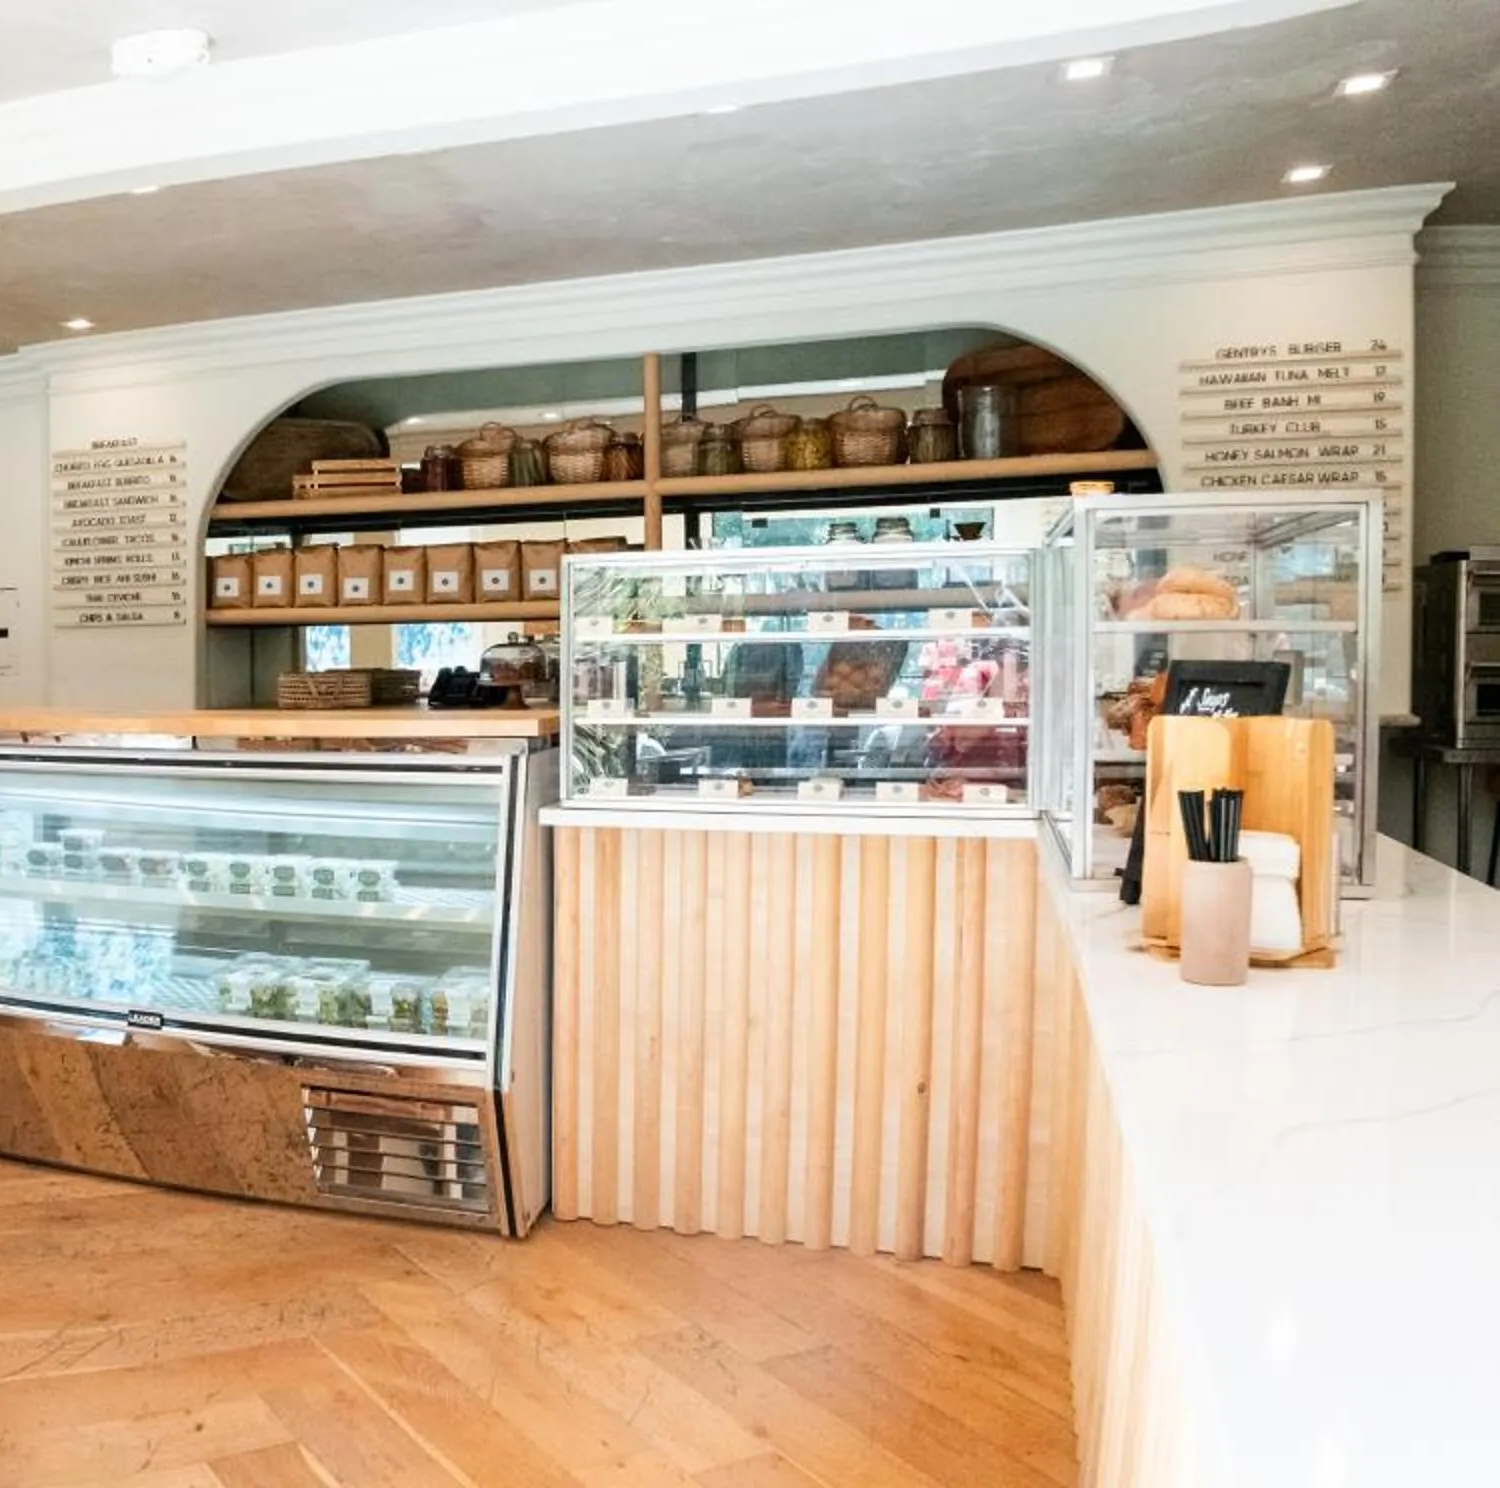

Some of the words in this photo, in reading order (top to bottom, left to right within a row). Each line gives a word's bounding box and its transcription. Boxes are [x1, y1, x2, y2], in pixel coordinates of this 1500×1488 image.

[1288, 341, 1342, 355] BURGER
[1370, 339, 1387, 351] 24
[1275, 369, 1309, 382] TUNA
[1318, 366, 1349, 379] MELT
[1224, 397, 1255, 410] BEEF
[1262, 396, 1299, 409] BANH
[1307, 394, 1321, 406] MI
[1230, 422, 1277, 435] TURKEY
[1285, 420, 1321, 434] CLUB
[1205, 450, 1249, 462] HONEY
[1254, 448, 1309, 461] SALMON
[1318, 444, 1359, 457] WRAP
[1373, 444, 1386, 457] 21
[1201, 476, 1257, 488] CHICKEN
[1261, 473, 1314, 486] CAESAR
[1317, 471, 1359, 484] WRAP
